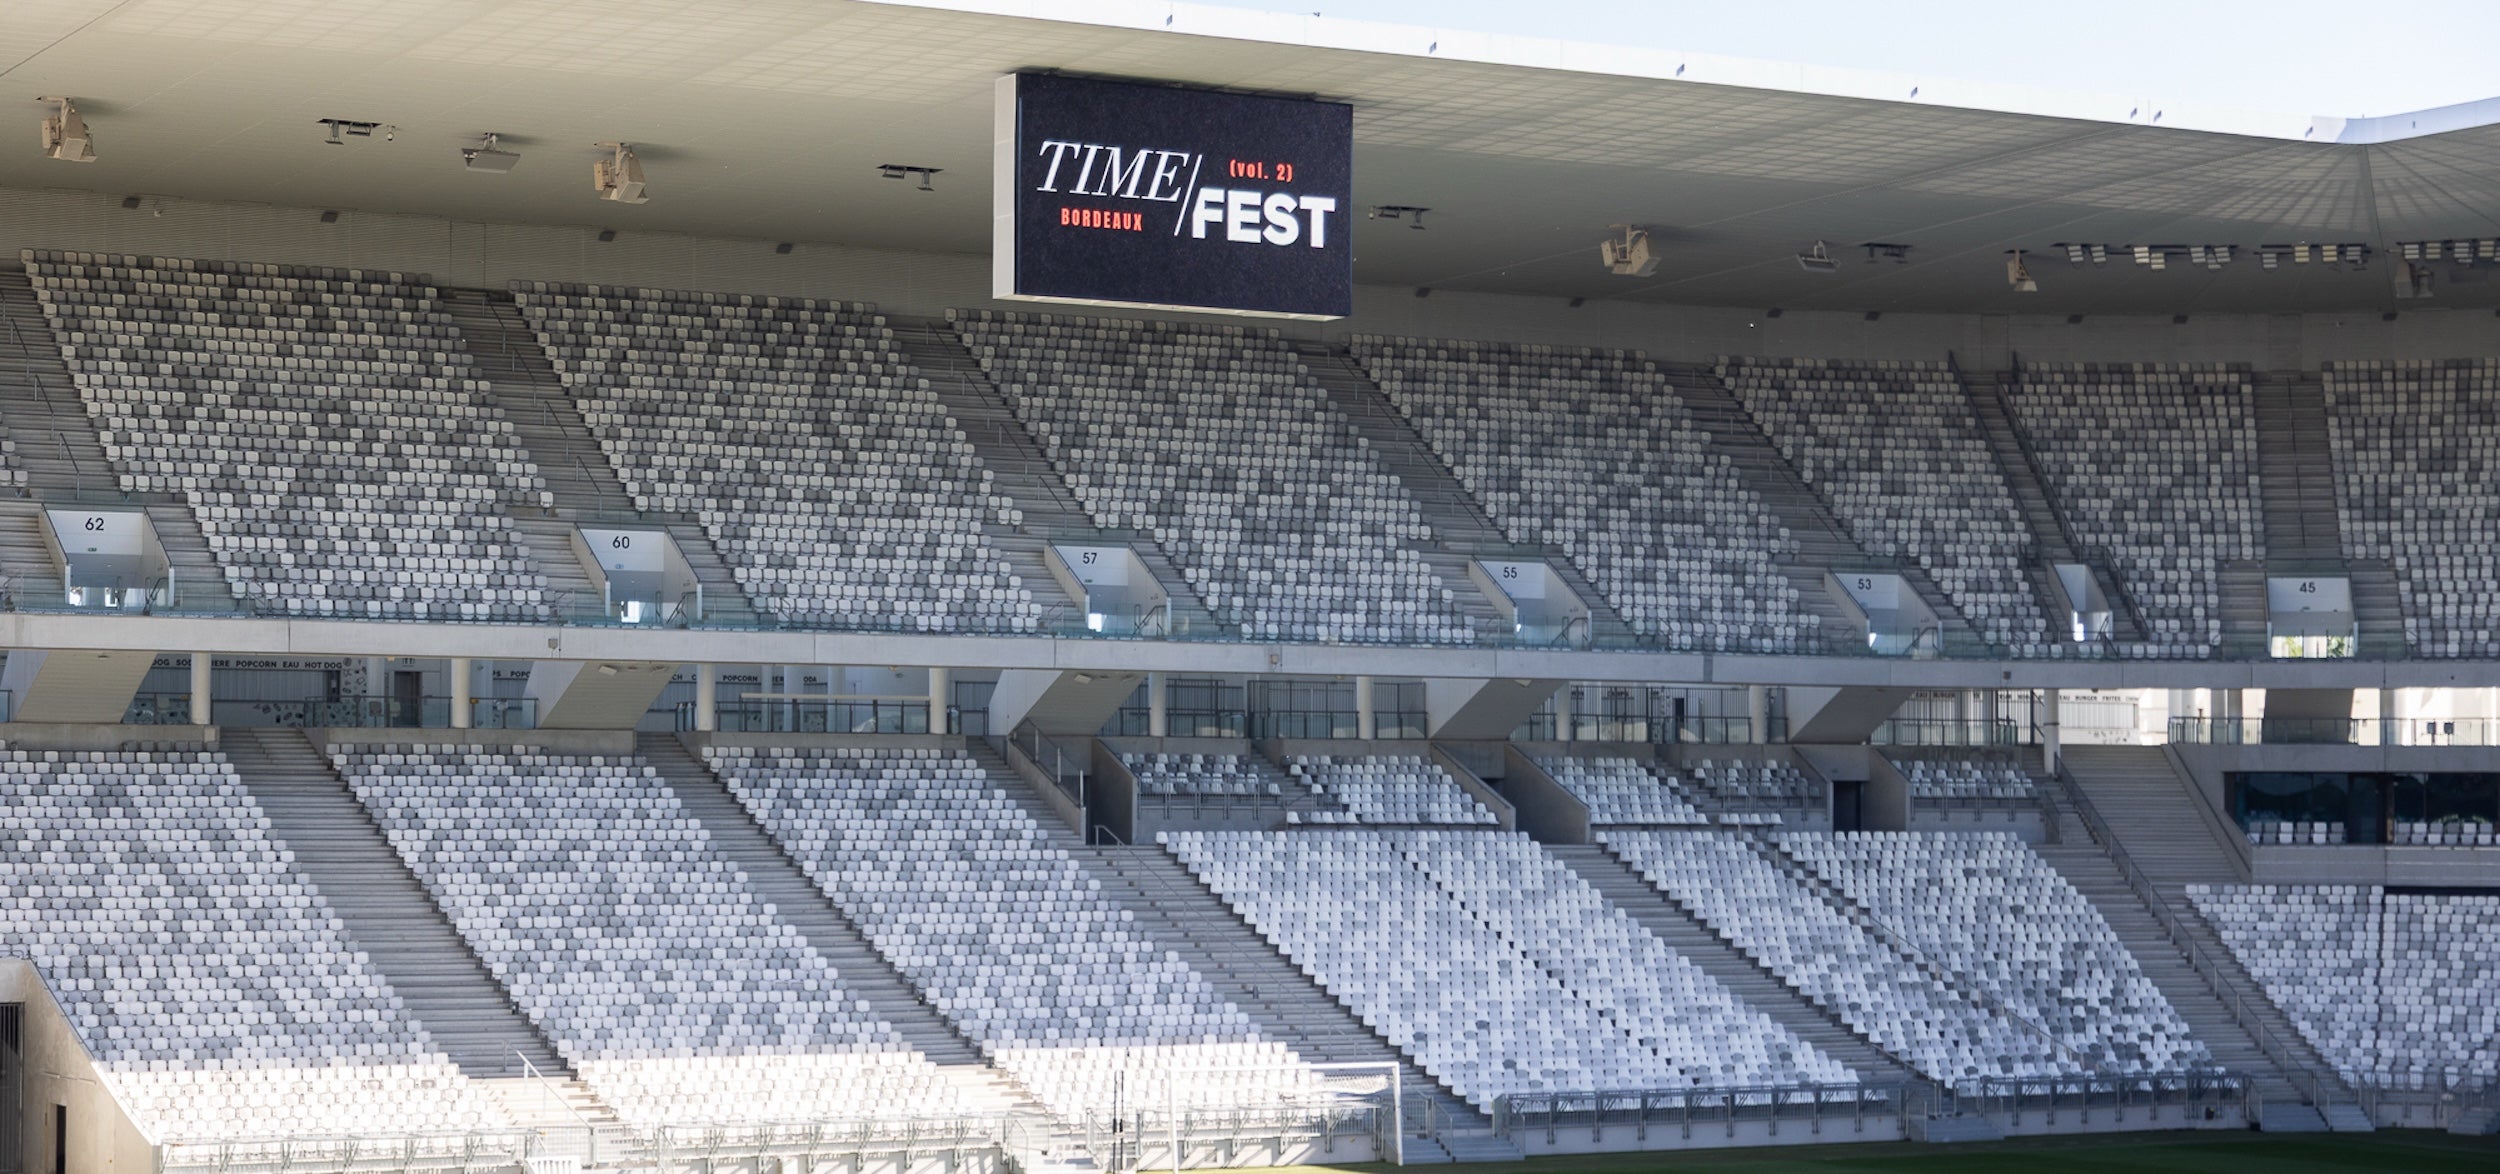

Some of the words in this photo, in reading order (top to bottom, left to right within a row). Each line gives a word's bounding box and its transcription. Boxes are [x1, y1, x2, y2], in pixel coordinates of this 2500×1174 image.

[1036, 140, 1190, 202] TIME
[1229, 159, 1269, 180] (vol.
[1276, 163, 1293, 183] 2)
[1060, 207, 1143, 232] BORDEAUX
[1192, 186, 1335, 249] FEST
[85, 517, 105, 531] 62
[612, 535, 630, 549] 60
[1082, 552, 1098, 565] 57
[1502, 566, 1518, 579] 55
[1857, 578, 1872, 590] 53
[2299, 581, 2316, 593] 45
[235, 660, 277, 668] POPCORN
[283, 661, 299, 669] EAU
[324, 662, 342, 670] DOG
